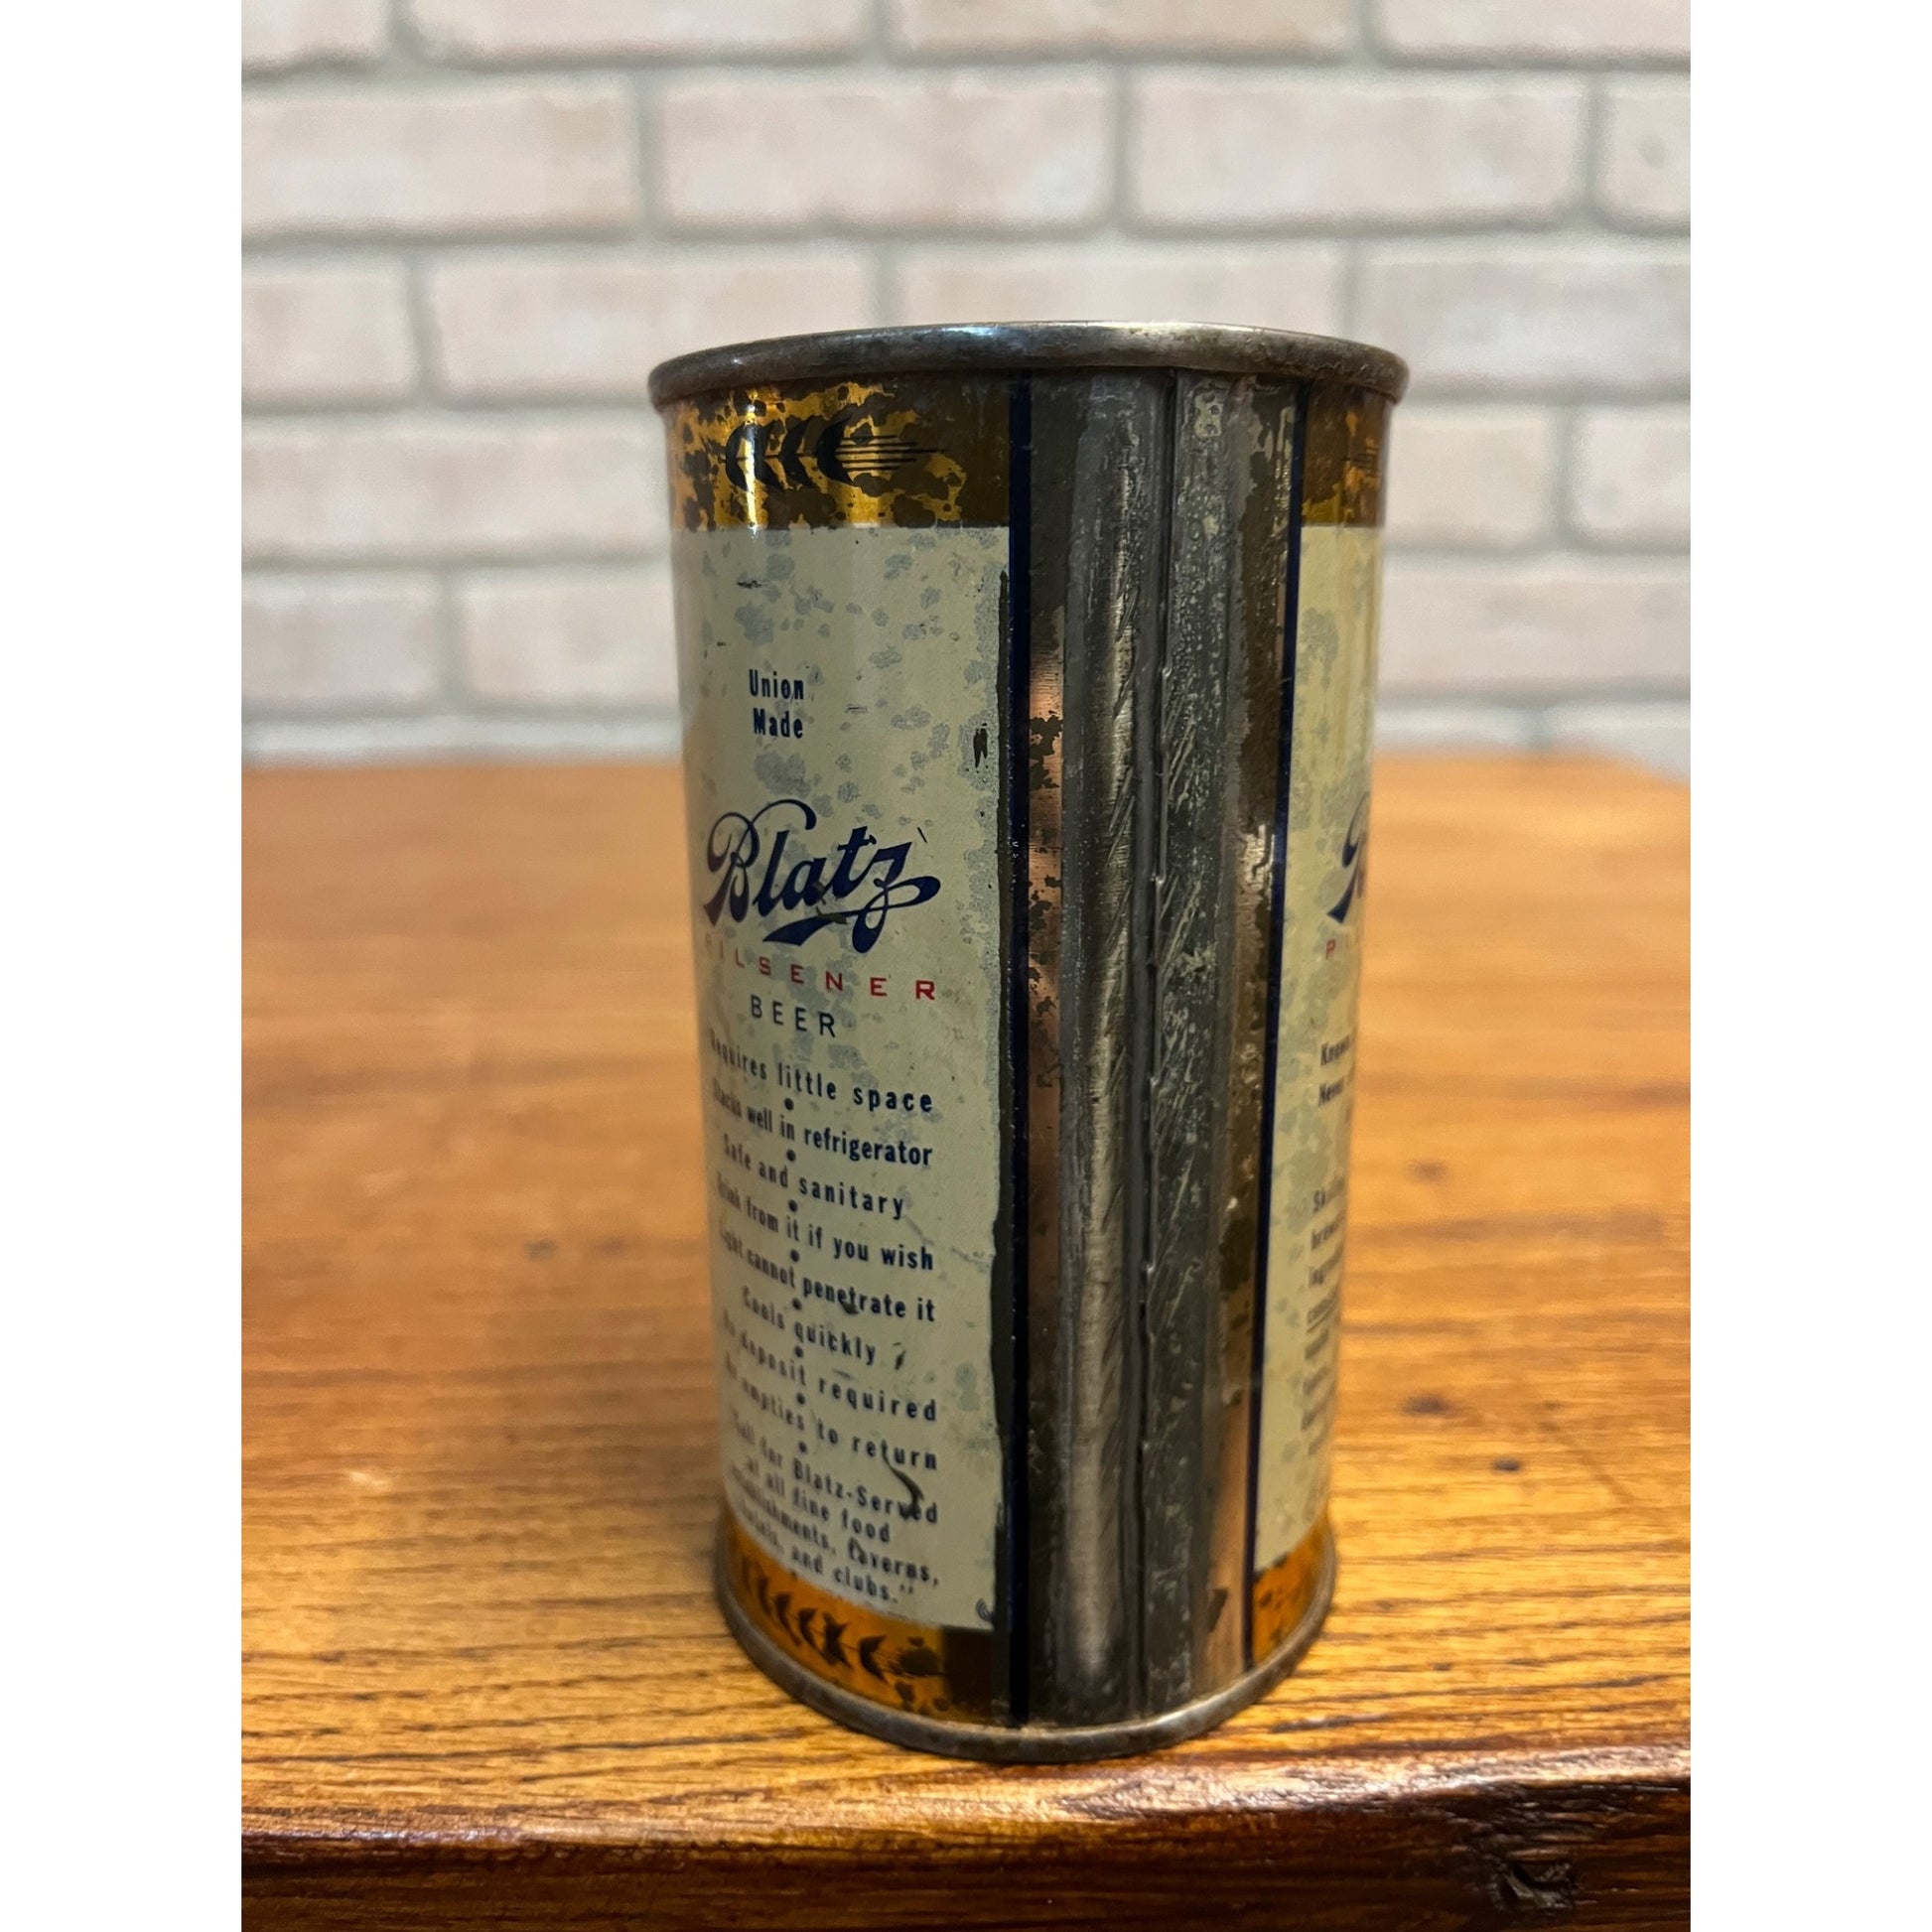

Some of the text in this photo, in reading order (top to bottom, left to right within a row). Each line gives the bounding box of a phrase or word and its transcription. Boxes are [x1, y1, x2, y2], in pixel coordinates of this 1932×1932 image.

[749, 669, 805, 699] Union
[753, 708, 804, 739] Made
[704, 798, 941, 953] Blatz
[705, 933, 936, 1001] PILSENER
[750, 994, 836, 1038] BEER
[777, 1061, 837, 1100] little
[852, 1086, 933, 1113] space
[747, 1105, 773, 1133] well
[780, 1113, 794, 1141] in
[804, 1127, 933, 1167] refrigerator
[759, 1161, 788, 1188] and
[798, 1173, 904, 1220] sanitary
[746, 1195, 779, 1233] from
[786, 1214, 800, 1242] it
[808, 1225, 823, 1249] if
[832, 1236, 870, 1261] you
[881, 1245, 934, 1271] wish
[747, 1248, 796, 1290] cannot
[802, 1277, 906, 1318] penetrate
[916, 1297, 936, 1322] it
[794, 1321, 877, 1366] quickly
[817, 1377, 937, 1423] required
[817, 1416, 839, 1445] to
[852, 1435, 938, 1471] return
[793, 1455, 938, 1525] Blatz-Served
[793, 1485, 830, 1522] fine
[842, 1507, 891, 1543] food
[791, 1545, 823, 1576] and
